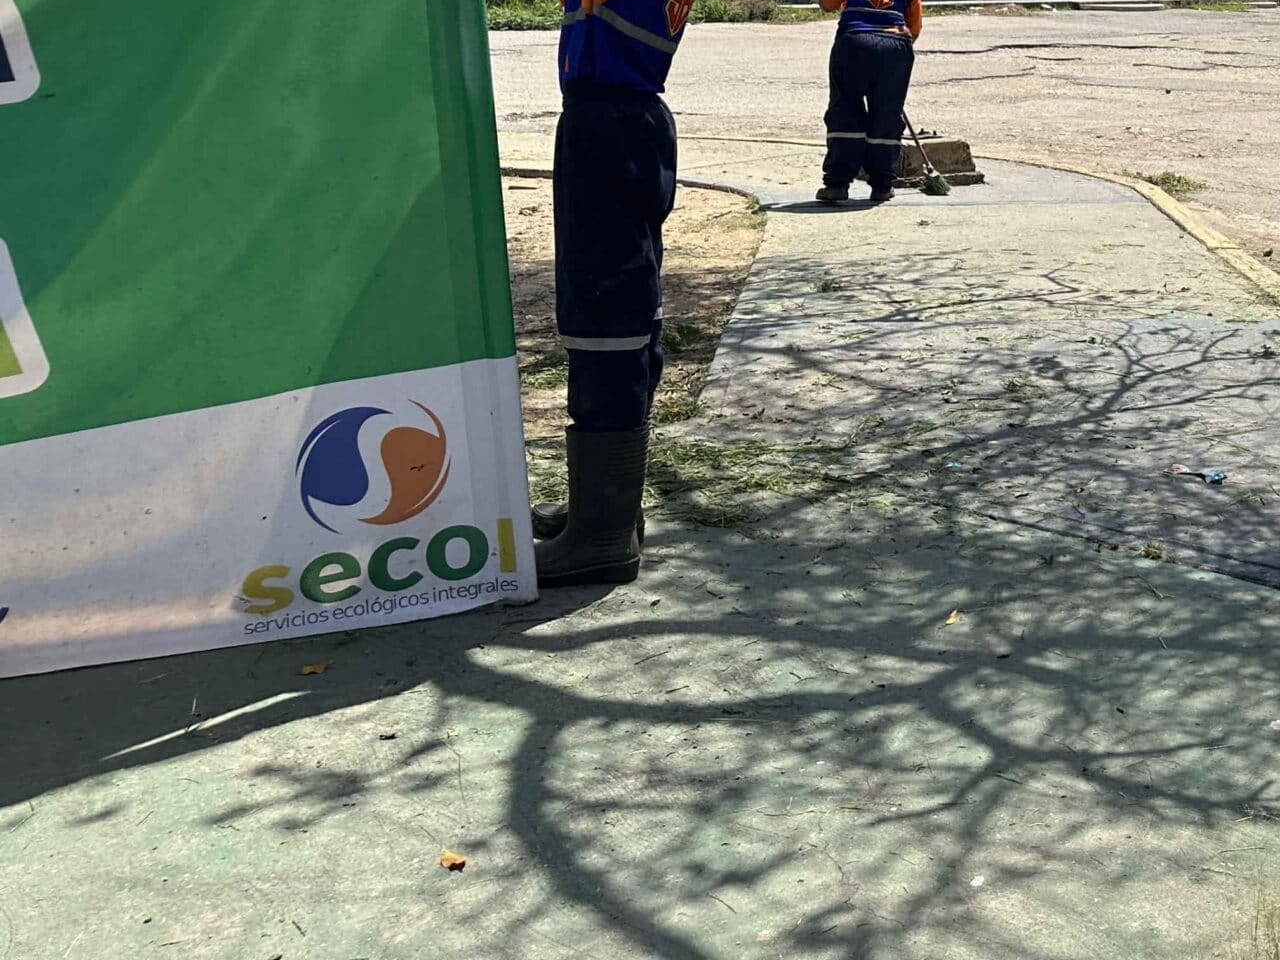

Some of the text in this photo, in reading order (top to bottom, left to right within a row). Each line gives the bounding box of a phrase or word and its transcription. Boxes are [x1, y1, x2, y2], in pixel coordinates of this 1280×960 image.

[242, 517, 518, 617] secol
[244, 577, 519, 635] servicios ecológicos integrales
